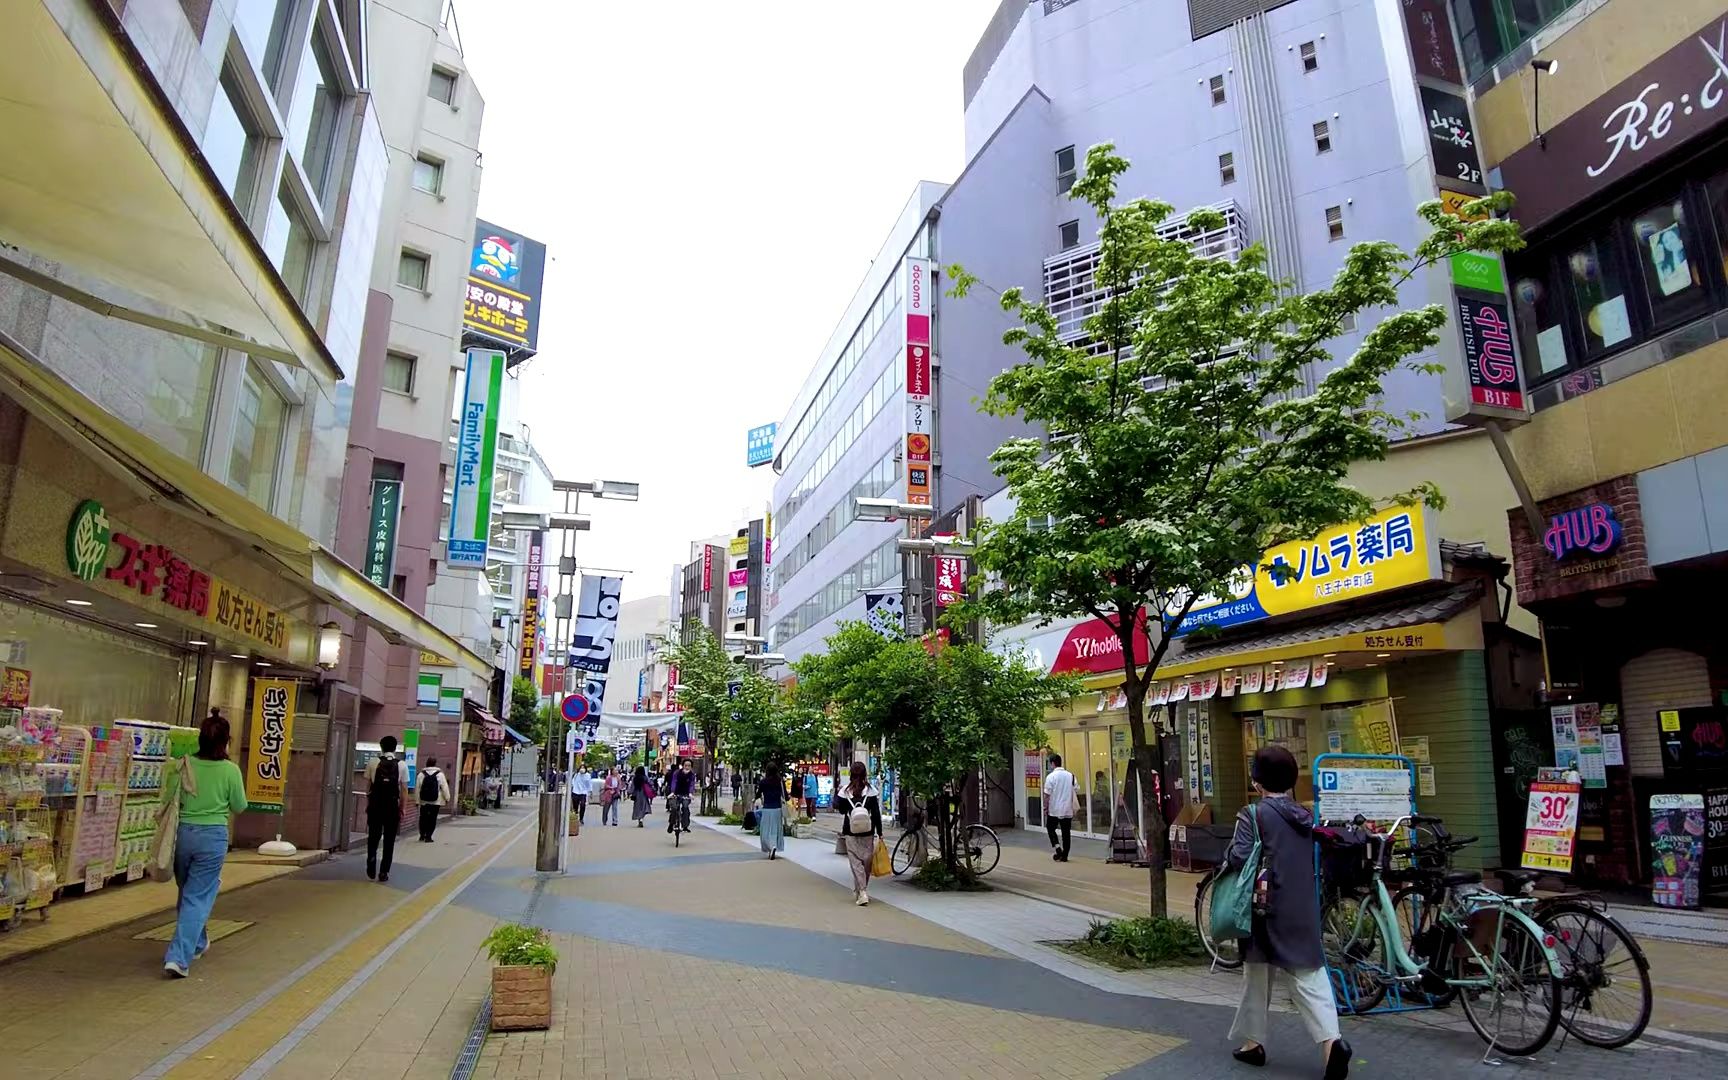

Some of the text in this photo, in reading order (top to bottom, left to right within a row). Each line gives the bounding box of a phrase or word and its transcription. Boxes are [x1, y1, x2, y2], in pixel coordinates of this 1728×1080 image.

[1457, 162, 1481, 183] 2F
[912, 264, 921, 309] docomo
[1460, 304, 1481, 385] BRITISH PUB
[1472, 306, 1516, 385] HUB
[460, 402, 484, 486] FamilyMart
[1544, 505, 1614, 561] HUB
[105, 532, 212, 617] スギ薬局
[1314, 571, 1374, 599] 八王子中町店
[216, 586, 286, 649] 処方せん受付
[1365, 635, 1423, 648] 処方せん受付
[1540, 796, 1566, 820] 30
[1708, 820, 1722, 838] 30
